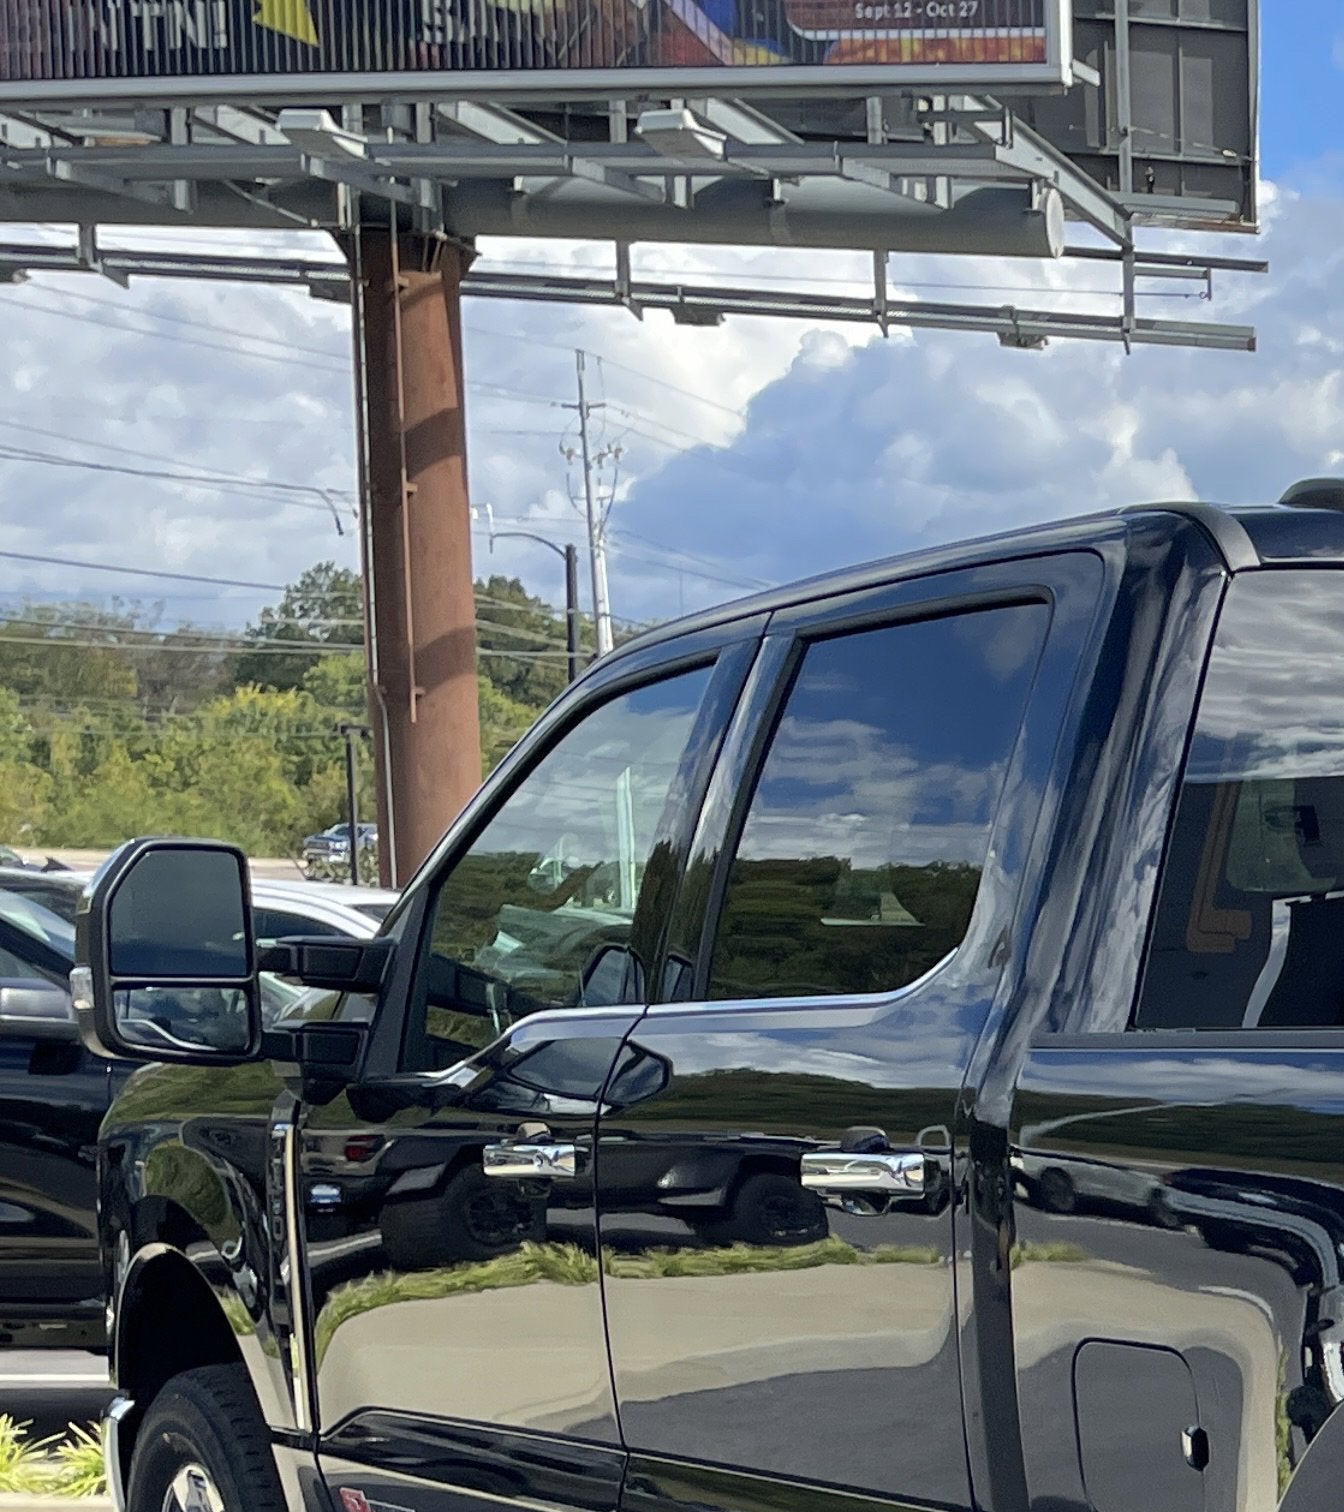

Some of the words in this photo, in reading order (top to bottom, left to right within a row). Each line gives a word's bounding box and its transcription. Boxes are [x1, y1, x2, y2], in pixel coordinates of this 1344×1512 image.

[855, 2, 890, 20] Sept
[894, 2, 912, 18] 12
[926, 1, 954, 17] Oct
[960, 1, 978, 17] 27
